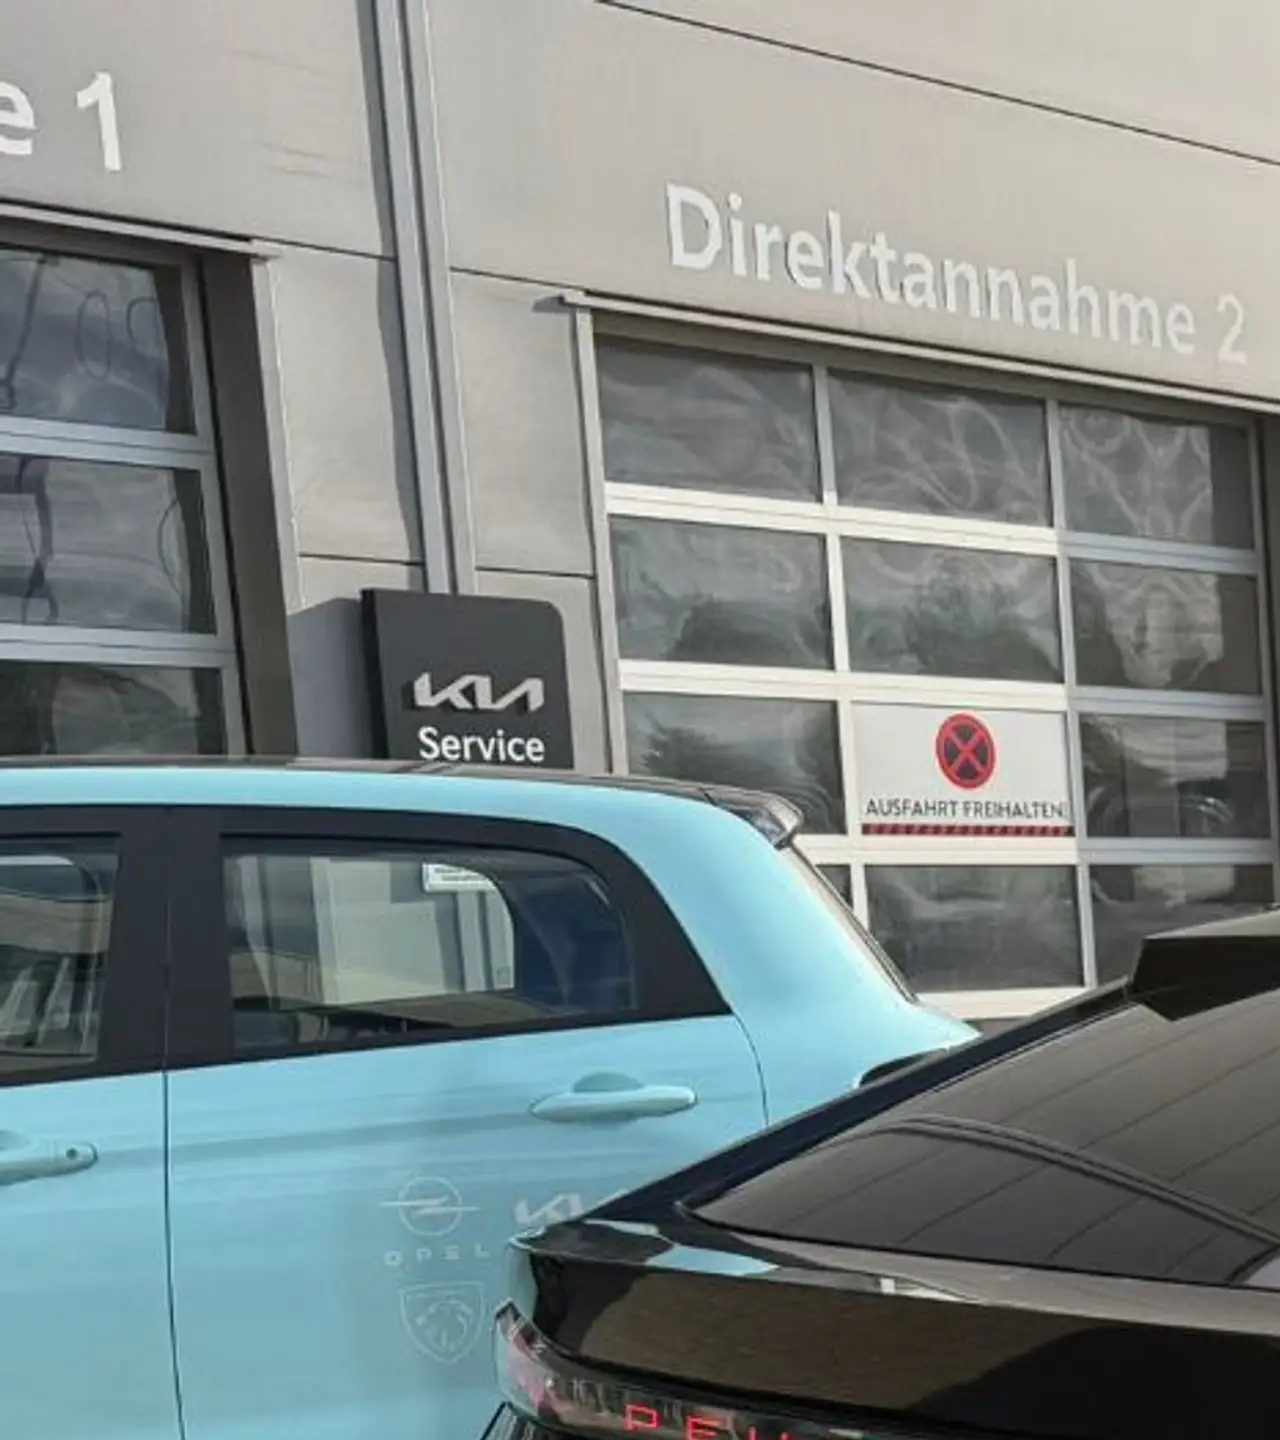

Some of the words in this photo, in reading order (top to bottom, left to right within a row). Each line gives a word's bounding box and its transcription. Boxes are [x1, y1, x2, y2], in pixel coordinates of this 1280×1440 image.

[77, 71, 122, 171] 1
[665, 181, 1197, 356] Direktannahme
[1216, 292, 1249, 366] 2
[413, 670, 545, 713] KIA
[417, 726, 546, 763] Service
[865, 798, 959, 818] AUSFAHRT
[961, 800, 1064, 819] FREIHALTEN
[384, 1243, 491, 1267] OPEL
